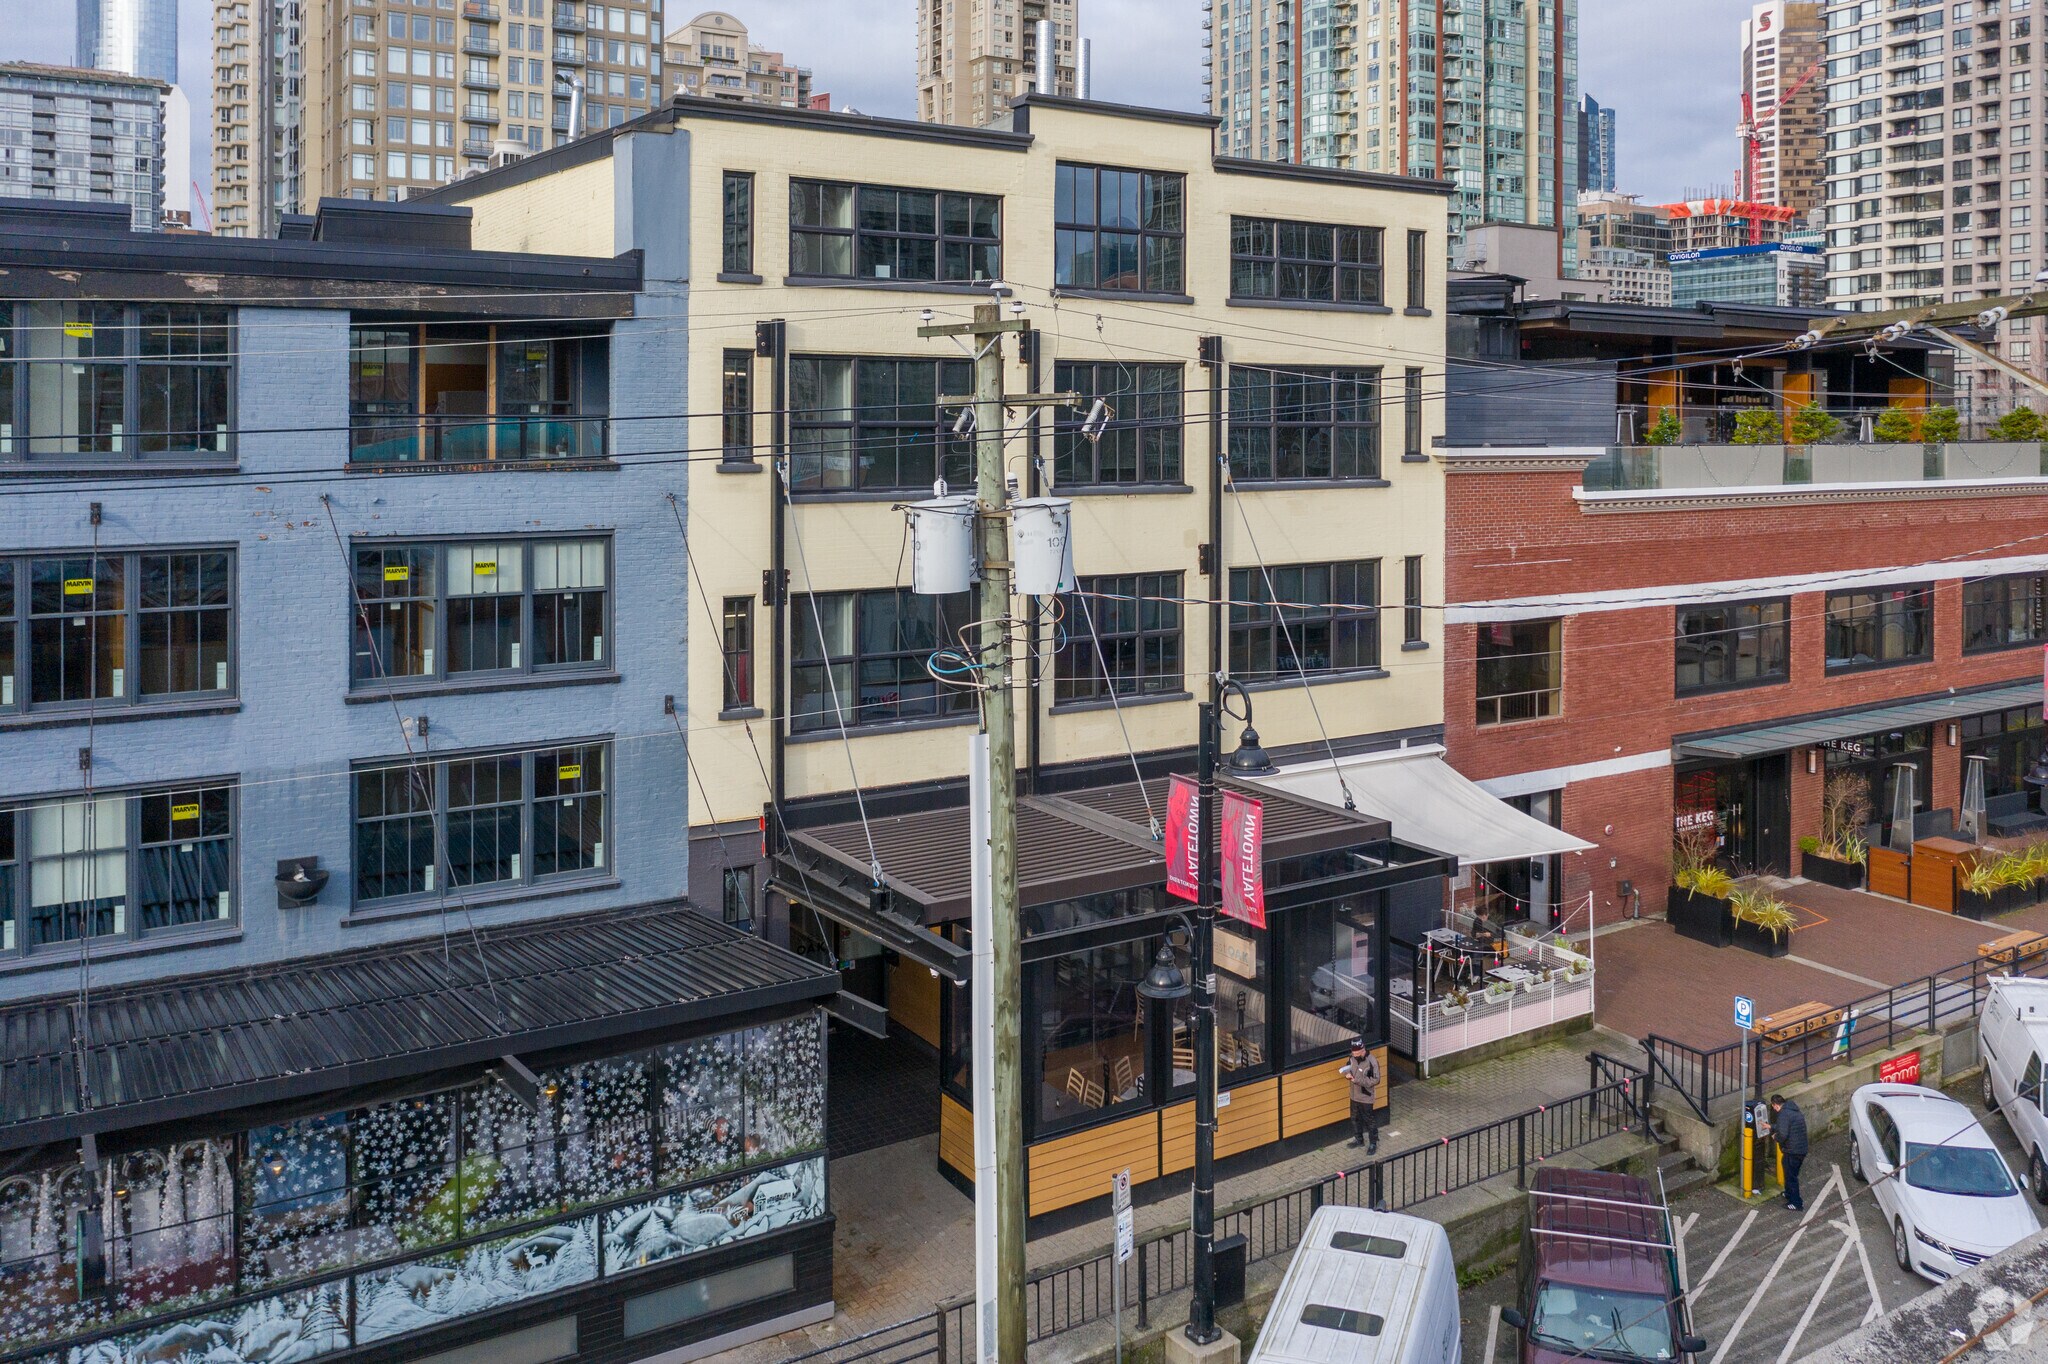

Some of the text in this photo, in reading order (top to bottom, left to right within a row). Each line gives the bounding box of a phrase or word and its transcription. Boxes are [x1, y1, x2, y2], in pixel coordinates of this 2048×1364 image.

[1840, 740, 1861, 752] KEG
[173, 805, 198, 814] MARVIN
[1676, 810, 1714, 828] THE KEG
